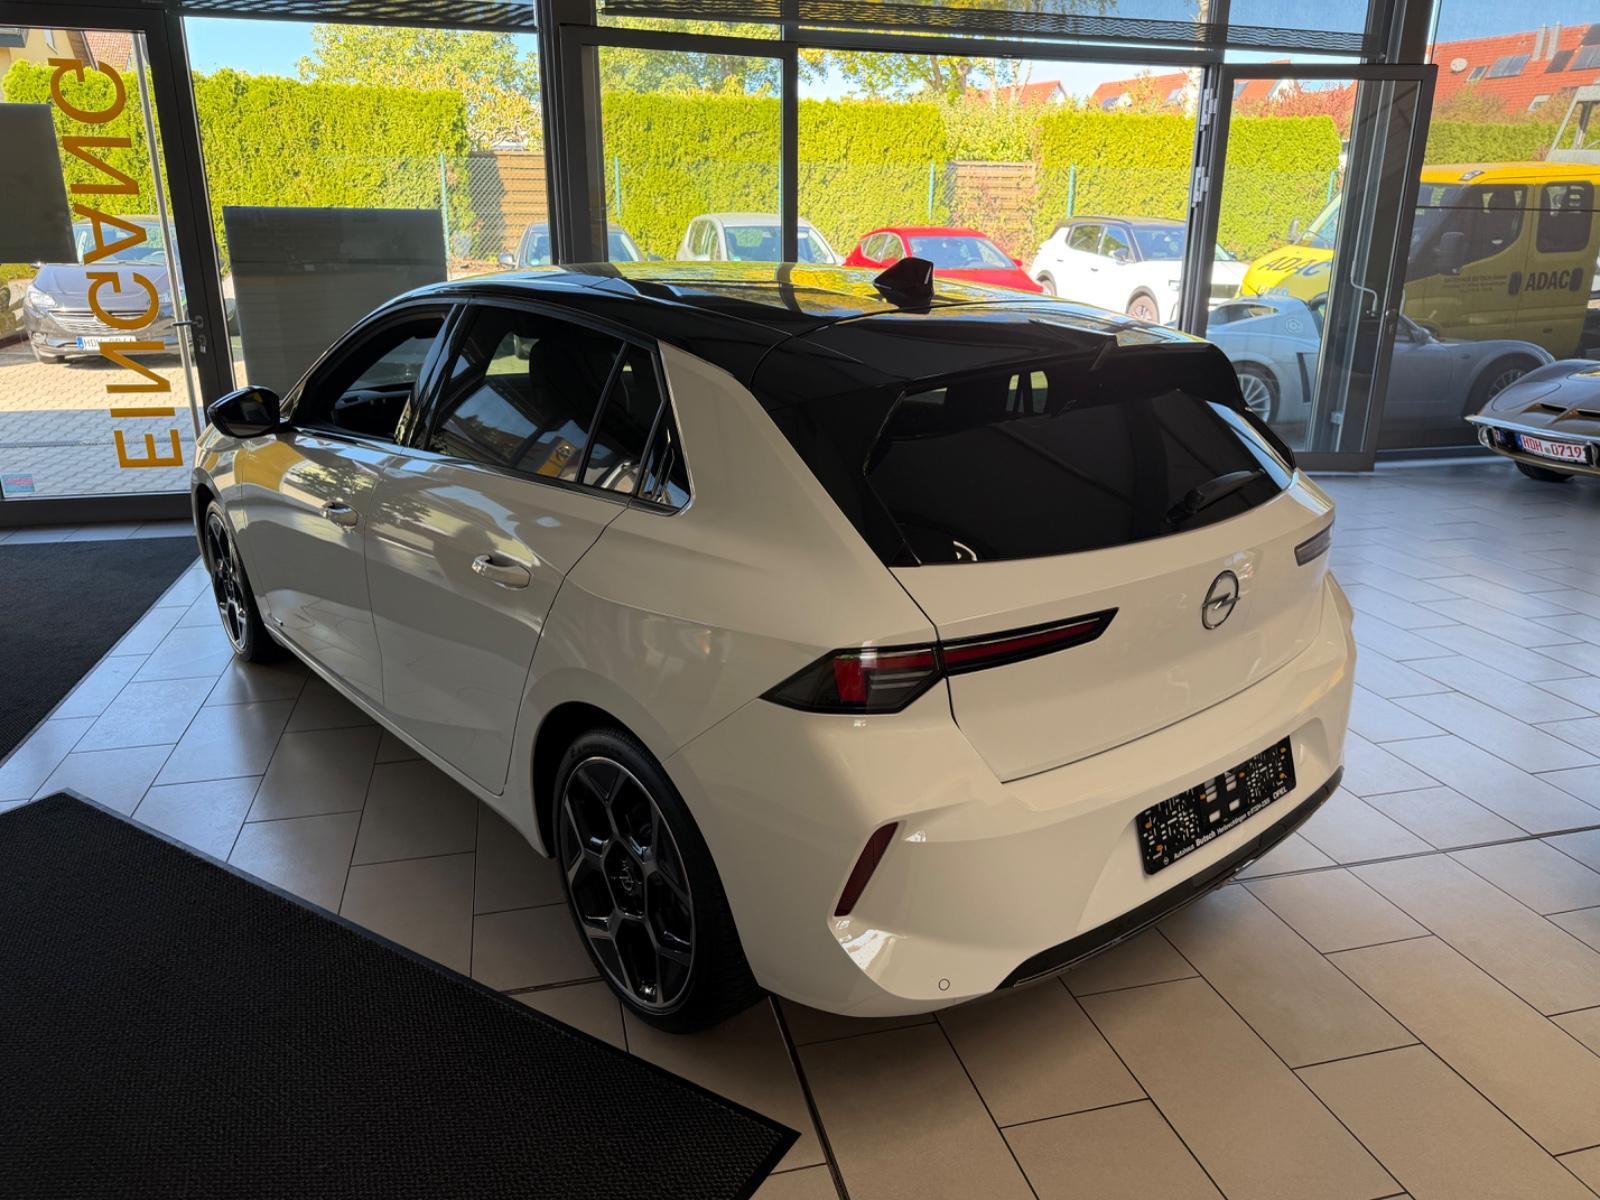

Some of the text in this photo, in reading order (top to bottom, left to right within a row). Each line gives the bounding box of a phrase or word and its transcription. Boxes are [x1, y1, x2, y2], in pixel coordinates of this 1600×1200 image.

[1258, 256, 1332, 277] ADAC
[1525, 270, 1570, 291] ADAC
[1195, 830, 1217, 847] Butsch
[1273, 786, 1288, 800] OPEL
